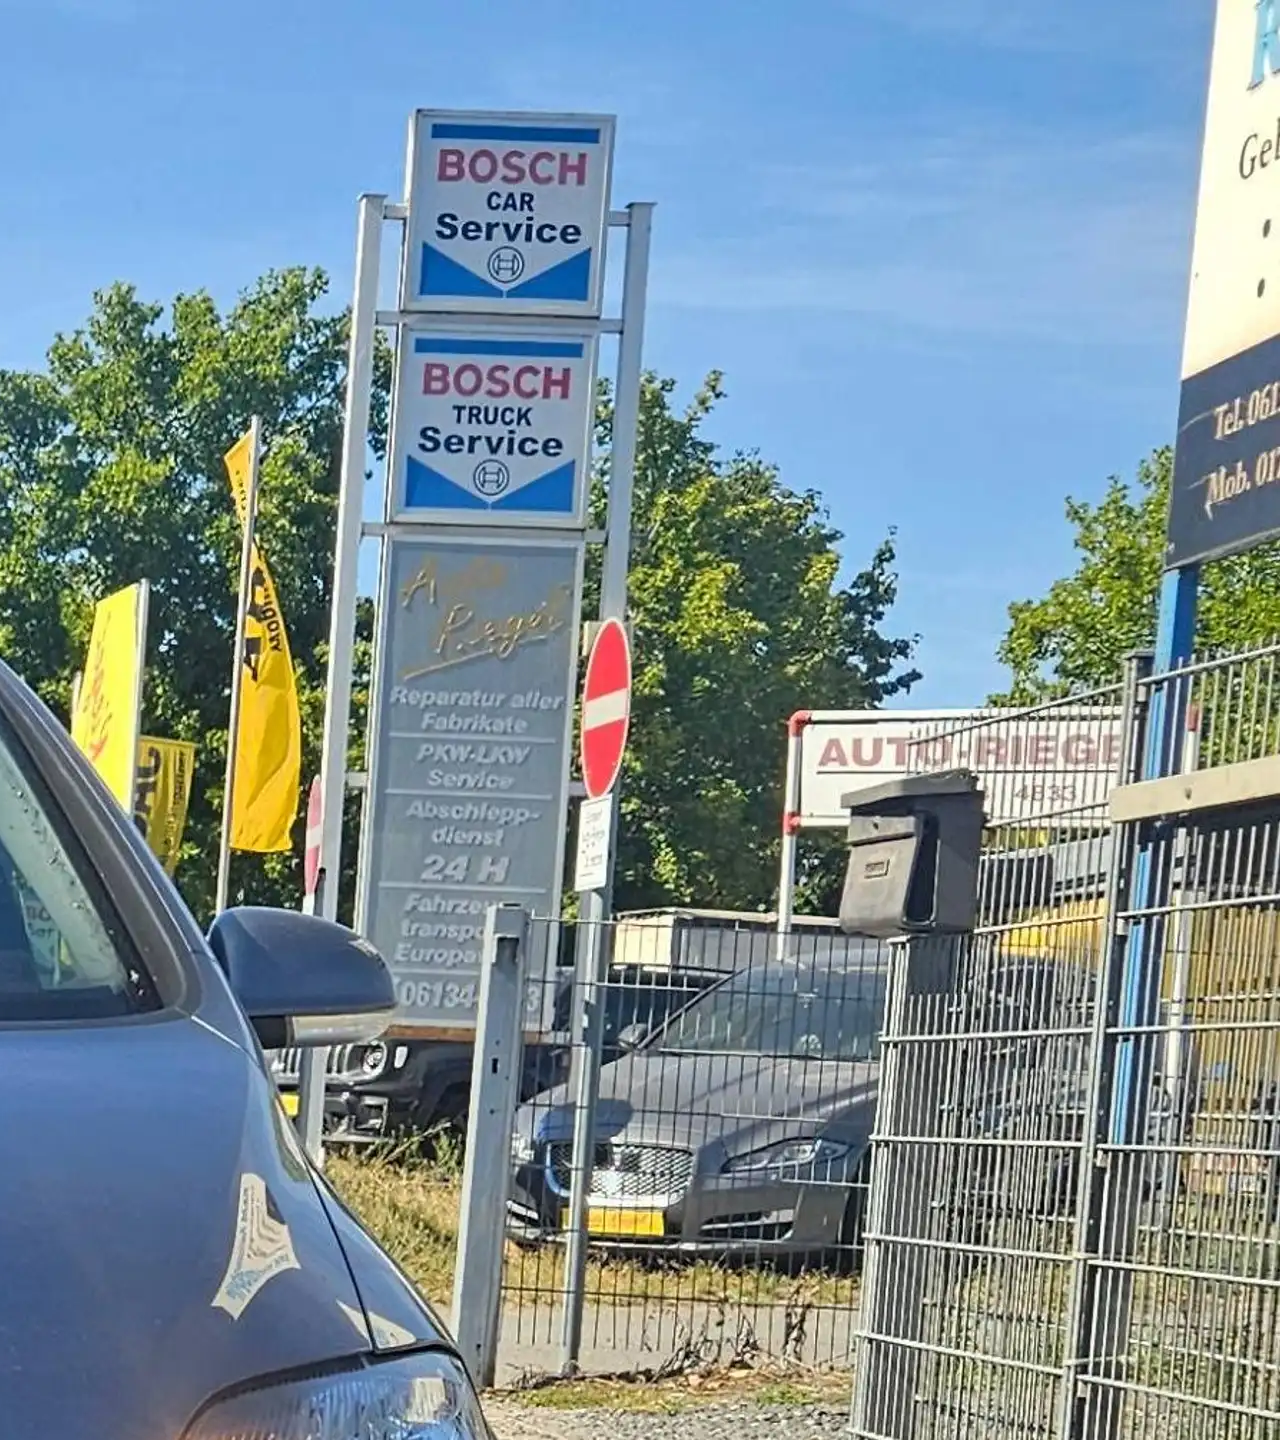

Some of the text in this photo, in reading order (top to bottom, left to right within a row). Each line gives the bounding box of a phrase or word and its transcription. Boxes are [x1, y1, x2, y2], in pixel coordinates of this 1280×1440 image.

[437, 149, 588, 186] BOSCH
[486, 191, 535, 212] CAR
[435, 213, 583, 244] Service
[422, 363, 572, 399] BOSCH
[451, 405, 532, 427] TRUCK
[1214, 397, 1244, 440] Tel.
[418, 426, 564, 457] Service
[1207, 461, 1251, 506] Mob.
[390, 685, 565, 711] Reparatur aller
[420, 712, 529, 734] Fabrikate
[416, 743, 532, 765] PKW-LKW
[428, 769, 516, 790] Service
[406, 800, 542, 825] Abschlepp-
[432, 826, 505, 847] dienst
[421, 854, 511, 884] 24 H
[403, 893, 487, 915] Fahrze
[400, 919, 485, 942] transpo
[394, 942, 482, 965] Europa
